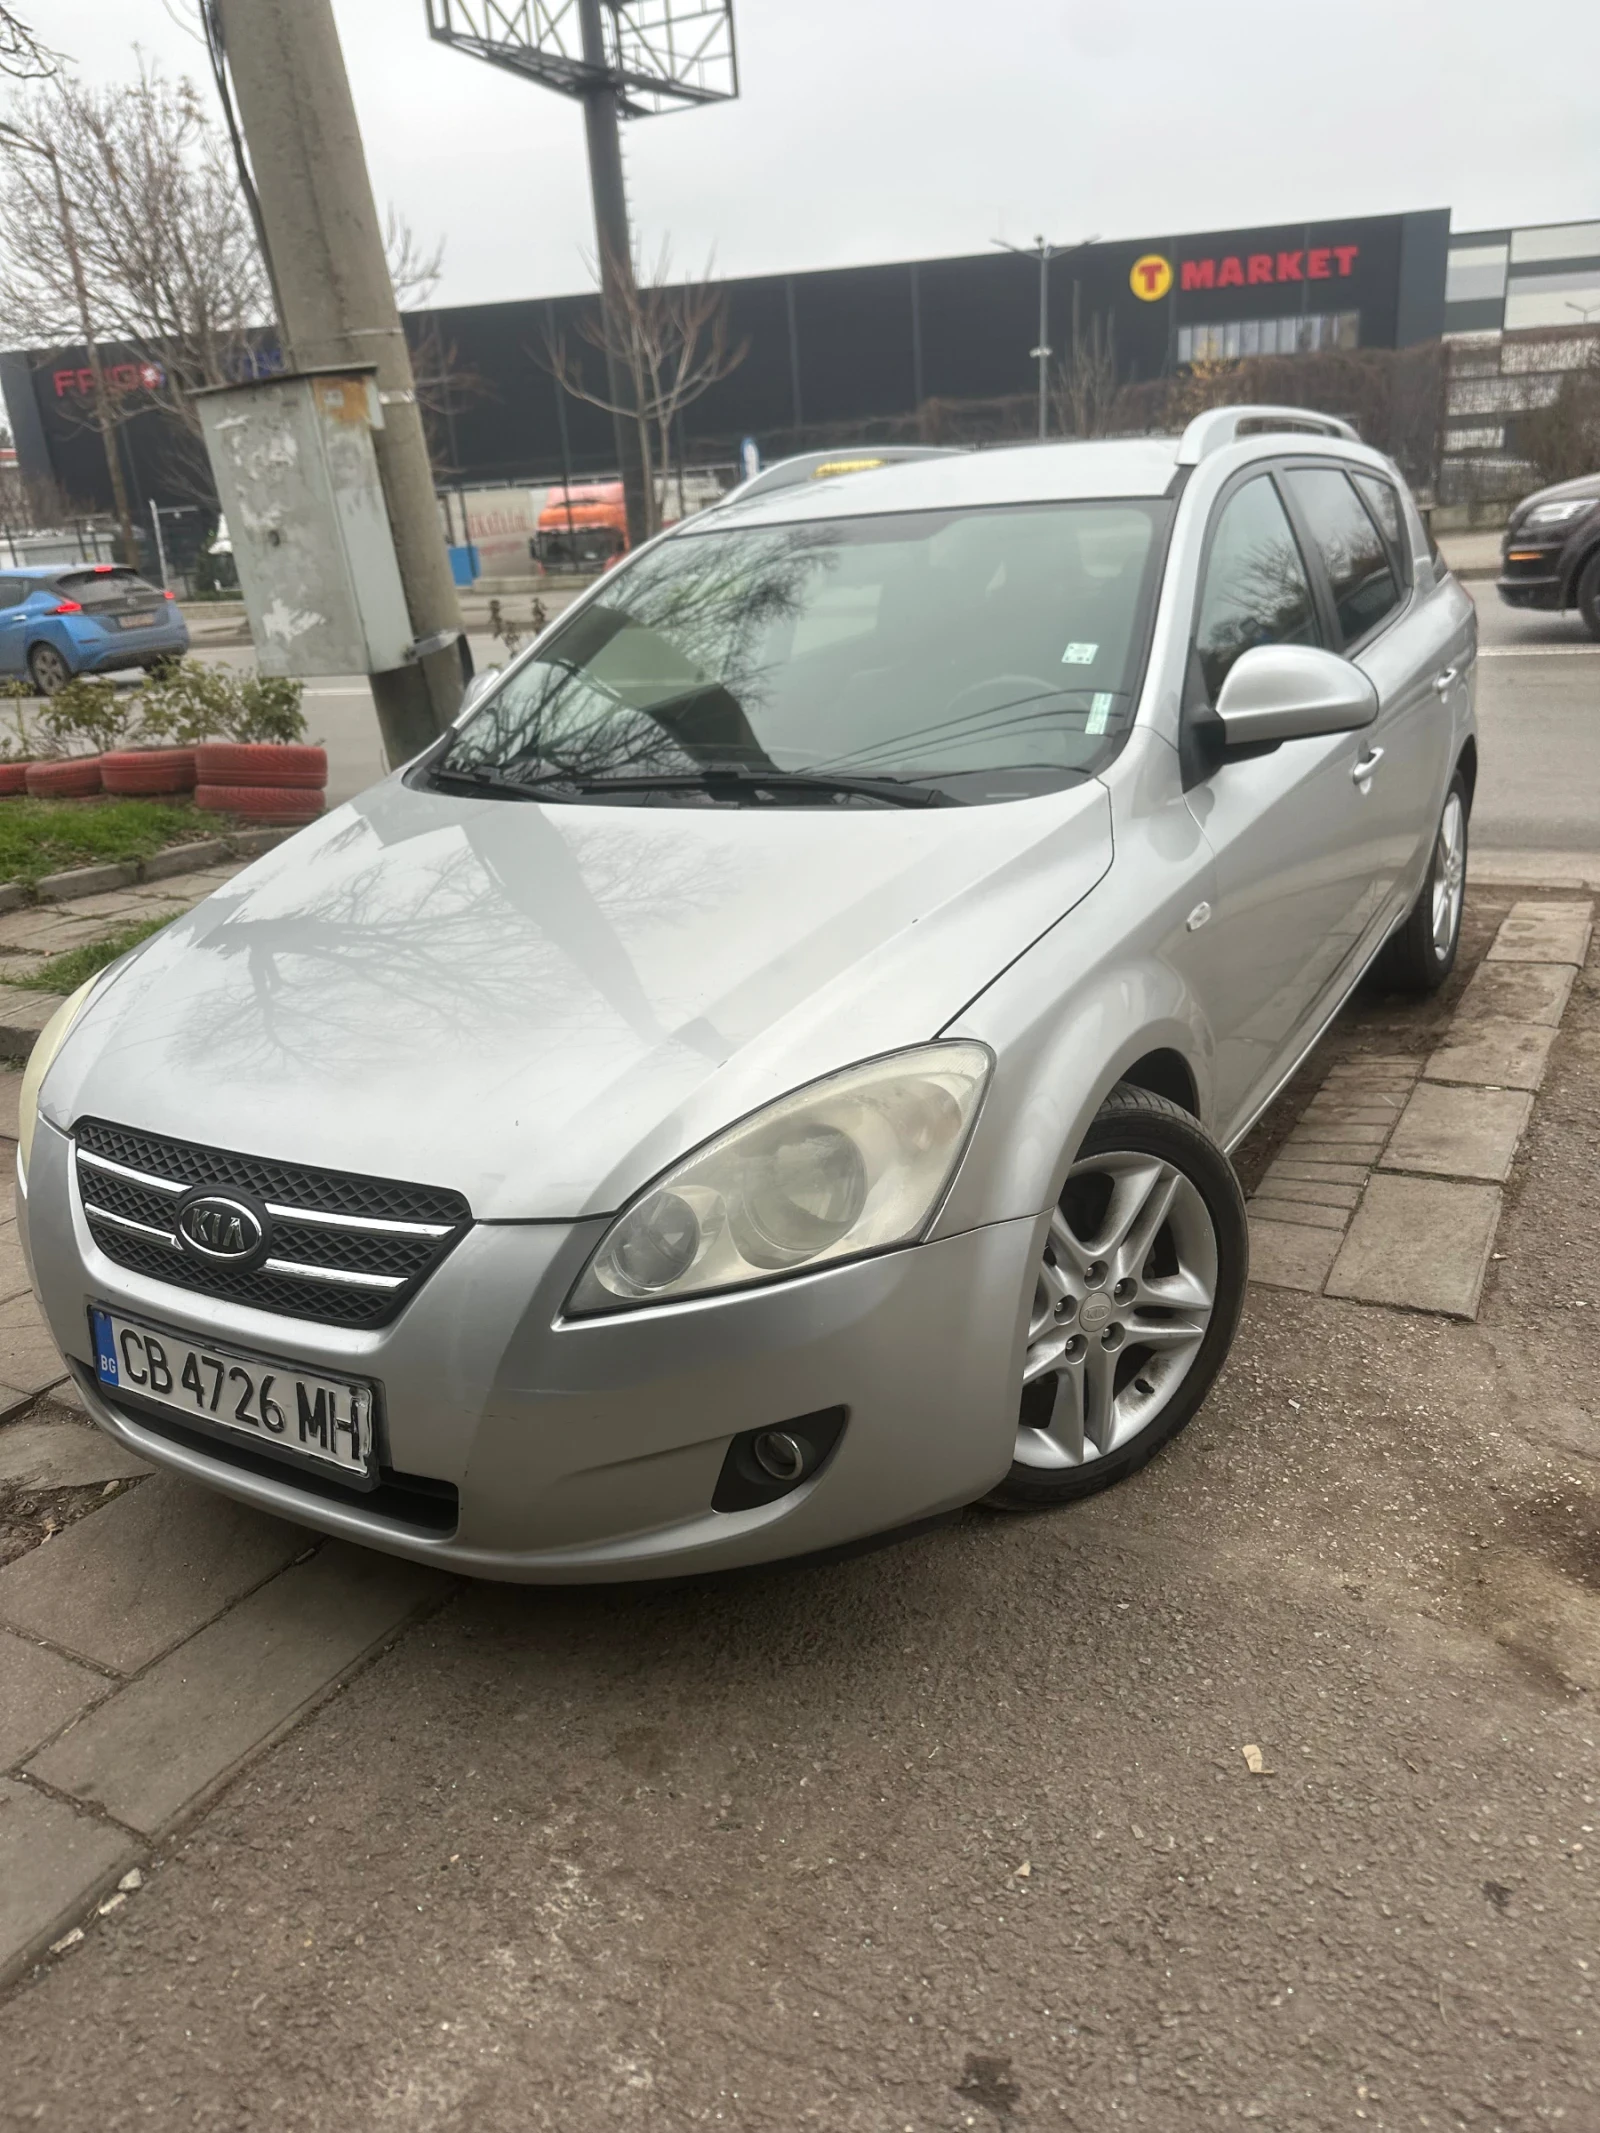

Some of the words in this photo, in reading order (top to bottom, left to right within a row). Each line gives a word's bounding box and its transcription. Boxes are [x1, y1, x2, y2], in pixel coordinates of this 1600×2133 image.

[1181, 245, 1358, 292] MARKET
[189, 1207, 246, 1250] KIA
[100, 1354, 117, 1374] BG
[119, 1327, 174, 1395] CB
[181, 1350, 286, 1434] 4726
[295, 1380, 360, 1461] MH
